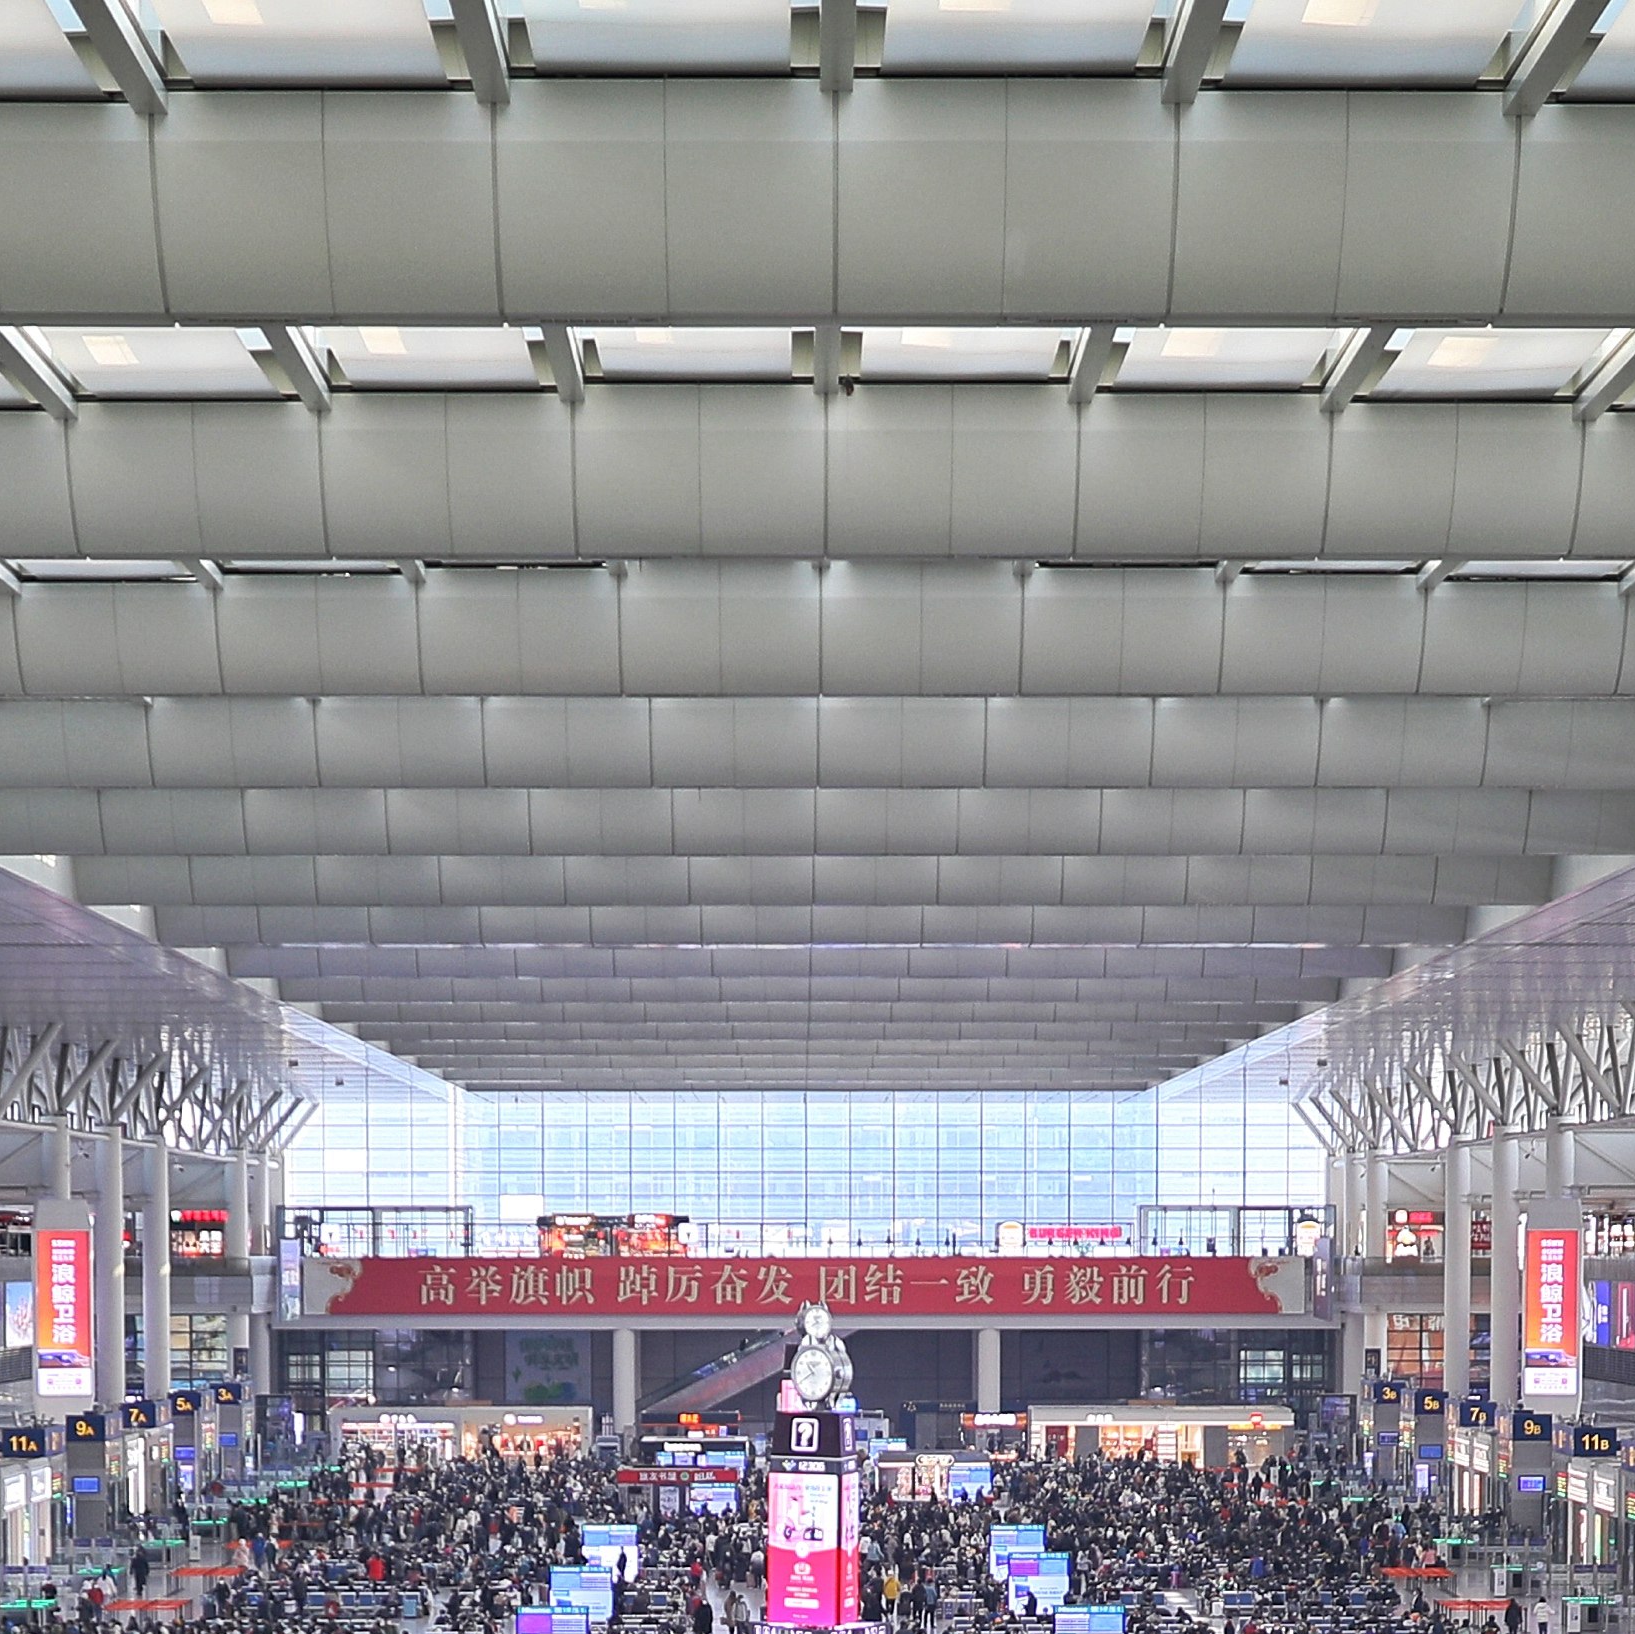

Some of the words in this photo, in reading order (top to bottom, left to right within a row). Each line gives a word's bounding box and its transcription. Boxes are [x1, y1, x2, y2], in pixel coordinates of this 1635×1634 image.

[420, 1265, 594, 1305] 高举旗帜
[618, 1265, 794, 1305] 踔厉奋发
[820, 1264, 995, 1305] 团结一致
[1021, 1264, 1195, 1305] 勇毅前行
[51, 1264, 76, 1344] 浪鲸卫浴
[1540, 1264, 1563, 1343] 浪鲸卫浴
[1381, 1386, 1397, 1400] 3B
[176, 1397, 192, 1412] 5A
[1423, 1396, 1440, 1411] 5B
[129, 1408, 147, 1423] 7A
[1470, 1407, 1487, 1422] 7B
[75, 1421, 94, 1437] 9A
[1524, 1420, 1542, 1436] 9B
[9, 1434, 39, 1453] 11A
[1581, 1433, 1610, 1452] 11B
[798, 1461, 826, 1471] 12306
